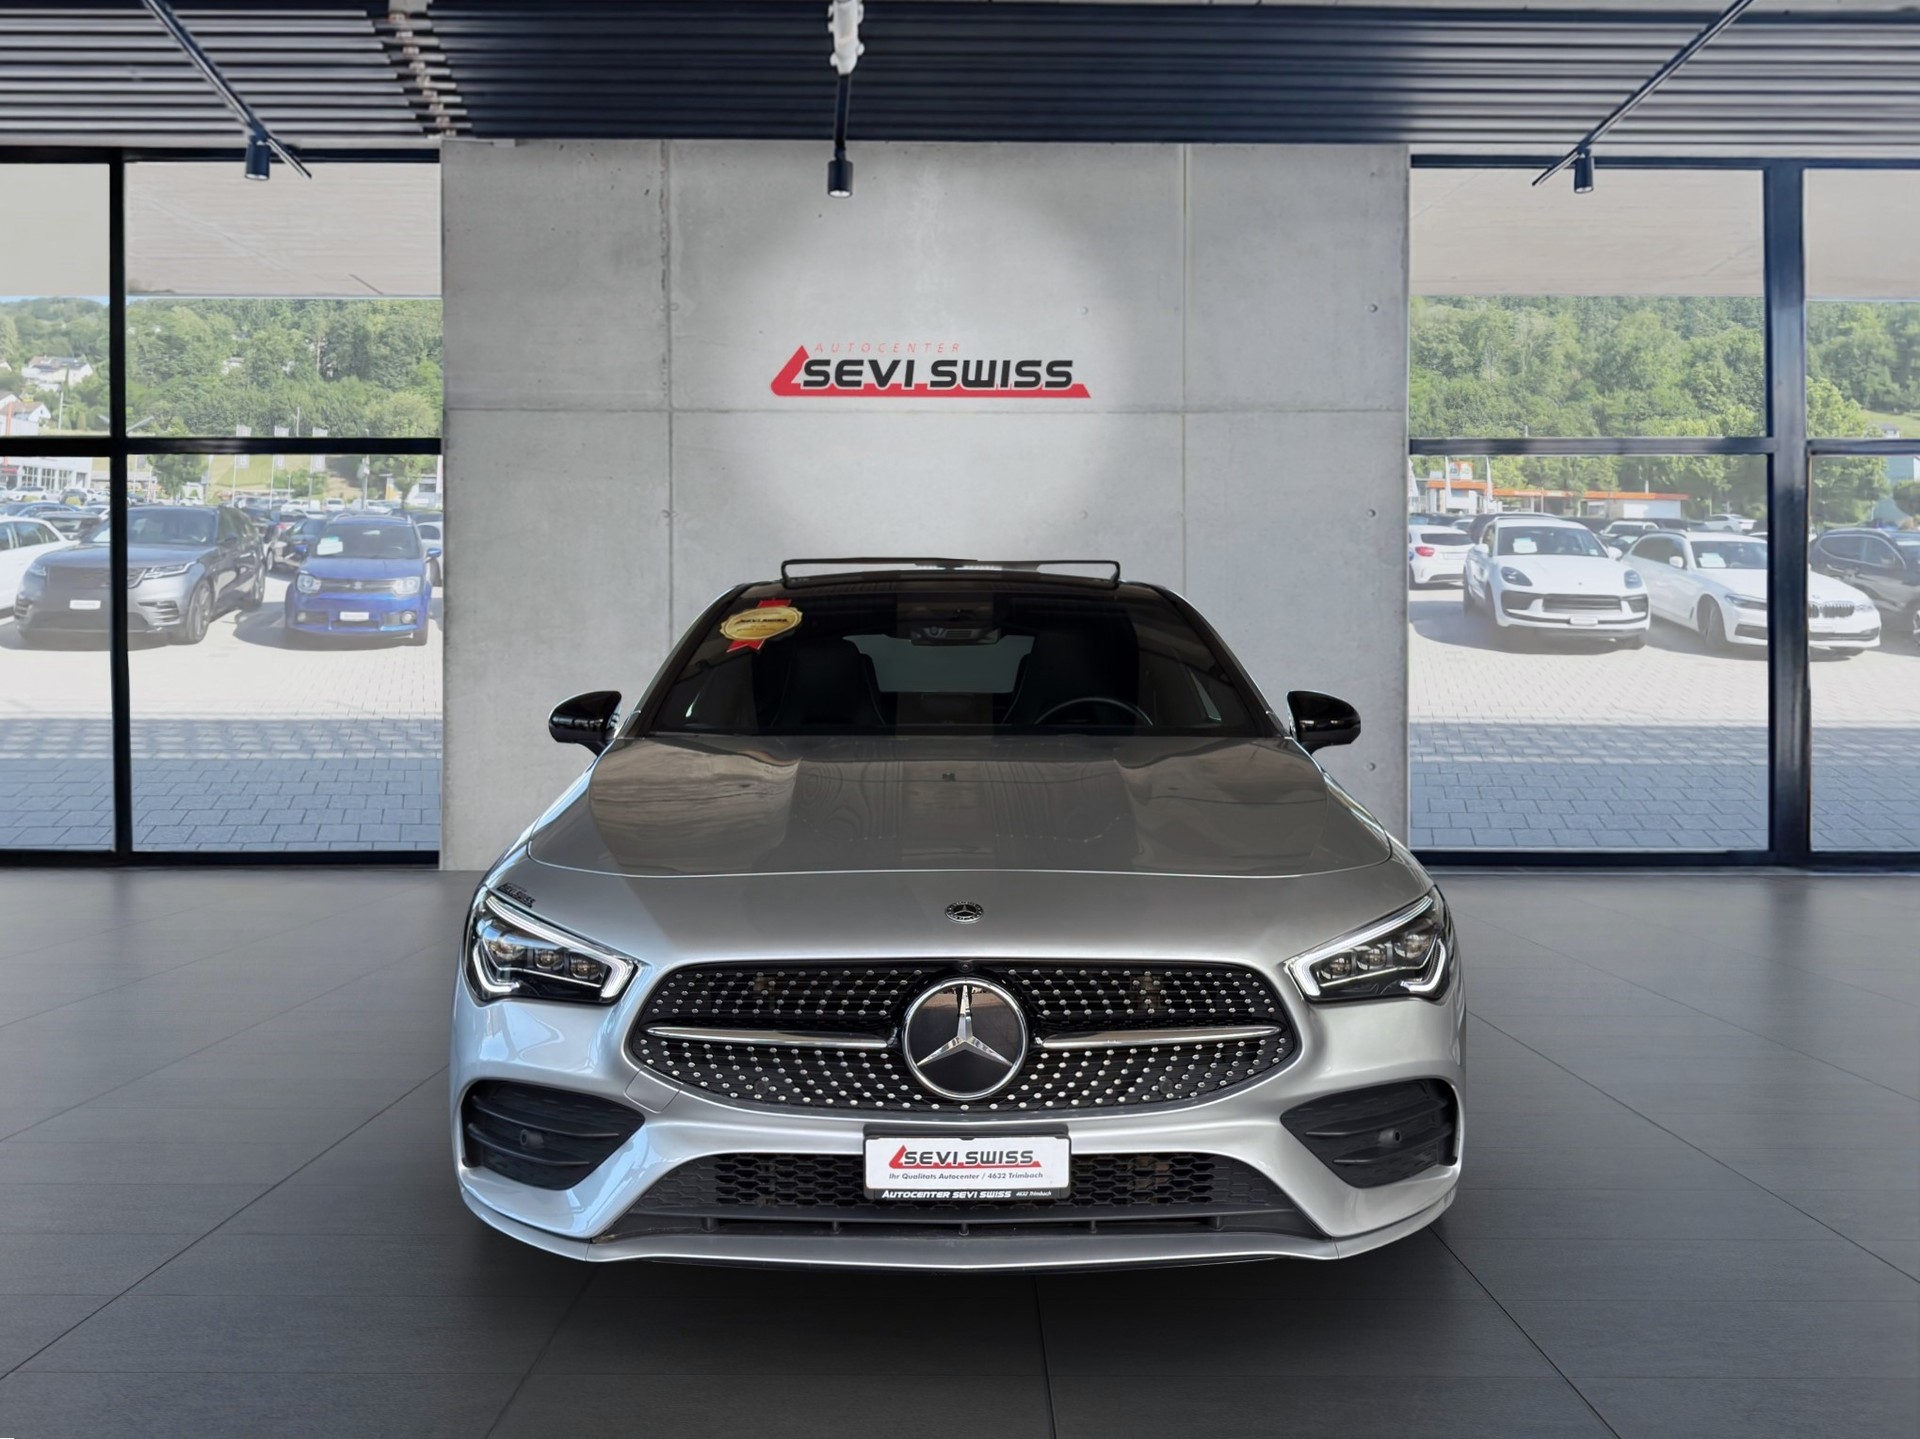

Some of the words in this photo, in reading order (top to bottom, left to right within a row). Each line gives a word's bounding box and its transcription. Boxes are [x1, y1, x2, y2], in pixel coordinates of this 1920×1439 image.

[815, 343, 961, 353] AUTOCENTER
[802, 359, 915, 388] SEVI
[929, 360, 1073, 388] SWISS
[903, 1151, 958, 1165] SEVI
[965, 1150, 1033, 1165] SWISS
[881, 1190, 951, 1199] AUTOCENTER
[952, 1191, 978, 1199] SEVI
[979, 1190, 1012, 1198] SWISS
